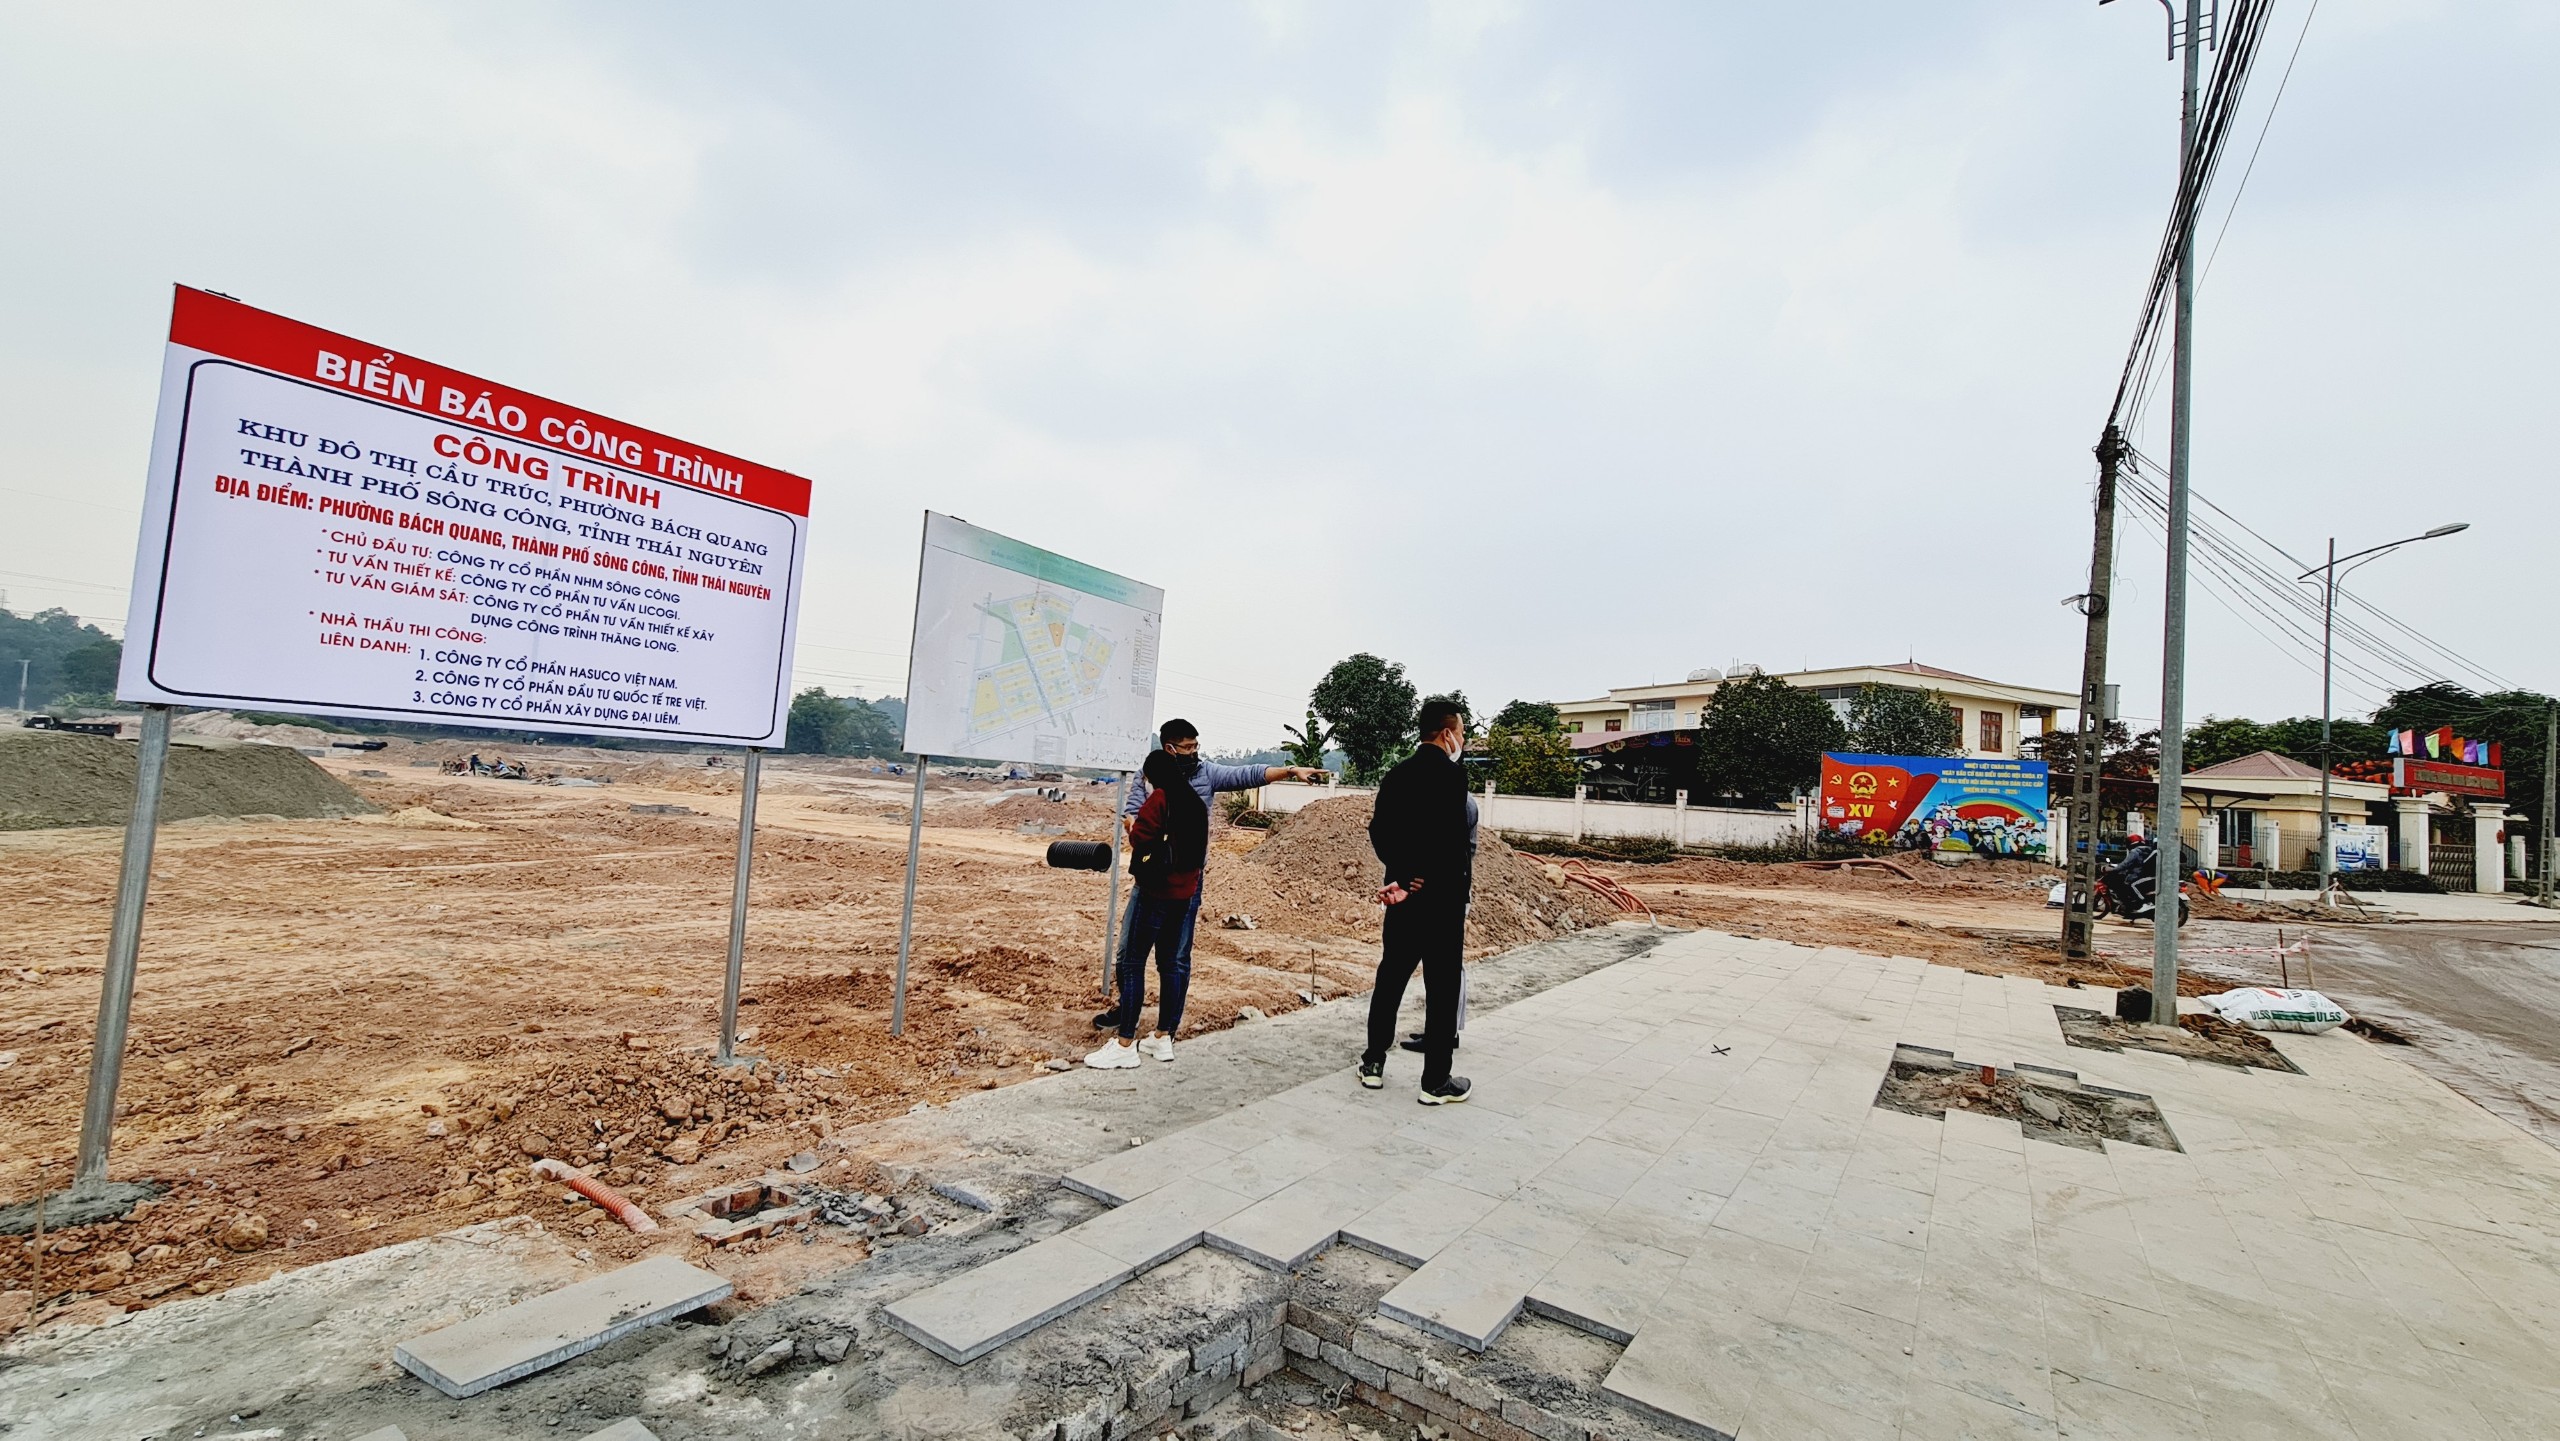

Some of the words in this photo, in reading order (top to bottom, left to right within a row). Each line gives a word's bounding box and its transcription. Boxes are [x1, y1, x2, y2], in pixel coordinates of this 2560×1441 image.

[315, 349, 425, 406] BIỂN
[439, 386, 527, 432] BÁO
[539, 417, 643, 466] CÔNG
[653, 448, 744, 495] TRÌNH
[236, 418, 309, 448] KHU
[317, 437, 361, 460] ĐÔ
[369, 449, 419, 478] THỊ
[425, 461, 479, 487] CẦU
[485, 477, 552, 507] TRÚC,
[558, 495, 646, 527] PHƯỜNG
[650, 517, 703, 541] BÁCH
[706, 532, 768, 556] QUANG
[433, 433, 549, 481] CÔNG
[561, 465, 661, 510] TRÌNH
[215, 474, 250, 500] ĐỊA
[256, 482, 314, 511] ĐIỂM:
[319, 496, 394, 526] PHƯỜNG
[398, 512, 445, 536] BÁCH
[448, 522, 506, 550] QUANG,
[511, 535, 559, 558] THÀNH
[562, 545, 591, 564] PHỐ
[592, 551, 629, 572] SÔNG
[631, 559, 668, 582] CÔNG,
[672, 565, 699, 586] TỈNH
[701, 574, 726, 592] THÁI
[728, 580, 771, 601] NGUYÊN
[240, 448, 354, 487] THÀNH
[360, 475, 422, 500] PHỐ
[426, 490, 497, 518] SÔNG
[503, 507, 571, 536] CÔNG,
[578, 521, 631, 547] TỈNH
[635, 536, 683, 559] THÁI
[687, 548, 764, 576] NGUYÊN
[328, 550, 348, 564] TƯ
[352, 553, 389, 572] VẤN
[393, 561, 432, 578] THIẾT
[434, 567, 456, 583] KẾ:
[460, 573, 508, 591] CÔNG
[511, 581, 527, 594] TY
[529, 583, 552, 598] CỔ
[555, 589, 590, 605] PHẦN
[593, 595, 608, 608] TƯ
[609, 598, 636, 613] VẤN
[638, 604, 681, 621] LICOGI.
[330, 530, 367, 547] CHỦ
[371, 536, 407, 555] ĐẦU
[411, 545, 433, 559] TƯ:
[437, 550, 486, 568] CÔNG
[489, 559, 505, 572] TY
[508, 561, 532, 576] CỔ
[534, 567, 571, 584] PHẦN
[573, 575, 603, 590] NHM
[605, 580, 642, 597] SÔNG
[644, 588, 681, 604] CÔNG
[320, 612, 358, 628] NHÀ
[363, 617, 404, 634] THẦU
[409, 623, 431, 637] THI
[434, 626, 487, 644] CÔNG:
[325, 570, 346, 585] TƯ
[349, 573, 386, 591] VẤN
[390, 581, 435, 599] GIÁM
[439, 587, 469, 604] SÁT:
[473, 594, 520, 611] CÔNG
[522, 602, 539, 614] TY
[540, 603, 563, 618] CỔ
[565, 608, 600, 624] PHẦN
[603, 615, 617, 626] TƯ
[619, 616, 645, 631] VẤN
[647, 622, 675, 636] THIẾT
[676, 625, 691, 639] KẾ
[692, 629, 715, 642] XÂY
[470, 612, 513, 629] DỰNG
[516, 619, 560, 635] CÔNG
[563, 625, 598, 641] TRÌNH
[600, 632, 642, 647] THĂNG
[644, 638, 679, 653] LONG.
[320, 631, 355, 648] LIÊN
[359, 637, 411, 654] DANH:
[420, 648, 430, 661] 1.
[435, 649, 483, 667] CÔNG
[486, 656, 502, 669] TY
[504, 655, 528, 672] CỔ
[530, 660, 567, 677] PHẦN
[569, 666, 621, 683] HASUCO
[624, 671, 647, 687] VIỆT
[648, 676, 678, 690] NAM.
[415, 669, 428, 682] 2.
[432, 670, 481, 687] CÔNG
[484, 676, 500, 689] TY
[502, 675, 525, 692] CỔ
[528, 680, 564, 696] PHẦN
[567, 682, 594, 699] ĐẦU
[597, 688, 611, 700] TƯ
[612, 689, 649, 704] QUỐC
[651, 691, 664, 706] TẾ
[665, 696, 682, 708] TRE
[684, 697, 707, 712] VIỆT.
[412, 690, 425, 703] 3.
[430, 690, 478, 708] CÔNG
[481, 696, 497, 709] TY
[500, 694, 523, 711] CỔ
[525, 698, 562, 715] PHẦN
[564, 702, 592, 717] XÂY
[593, 707, 629, 721] DỰNG
[631, 710, 652, 725] ĐẠI
[654, 711, 681, 725] LIÊM.
[1848, 803, 1875, 818] XV
